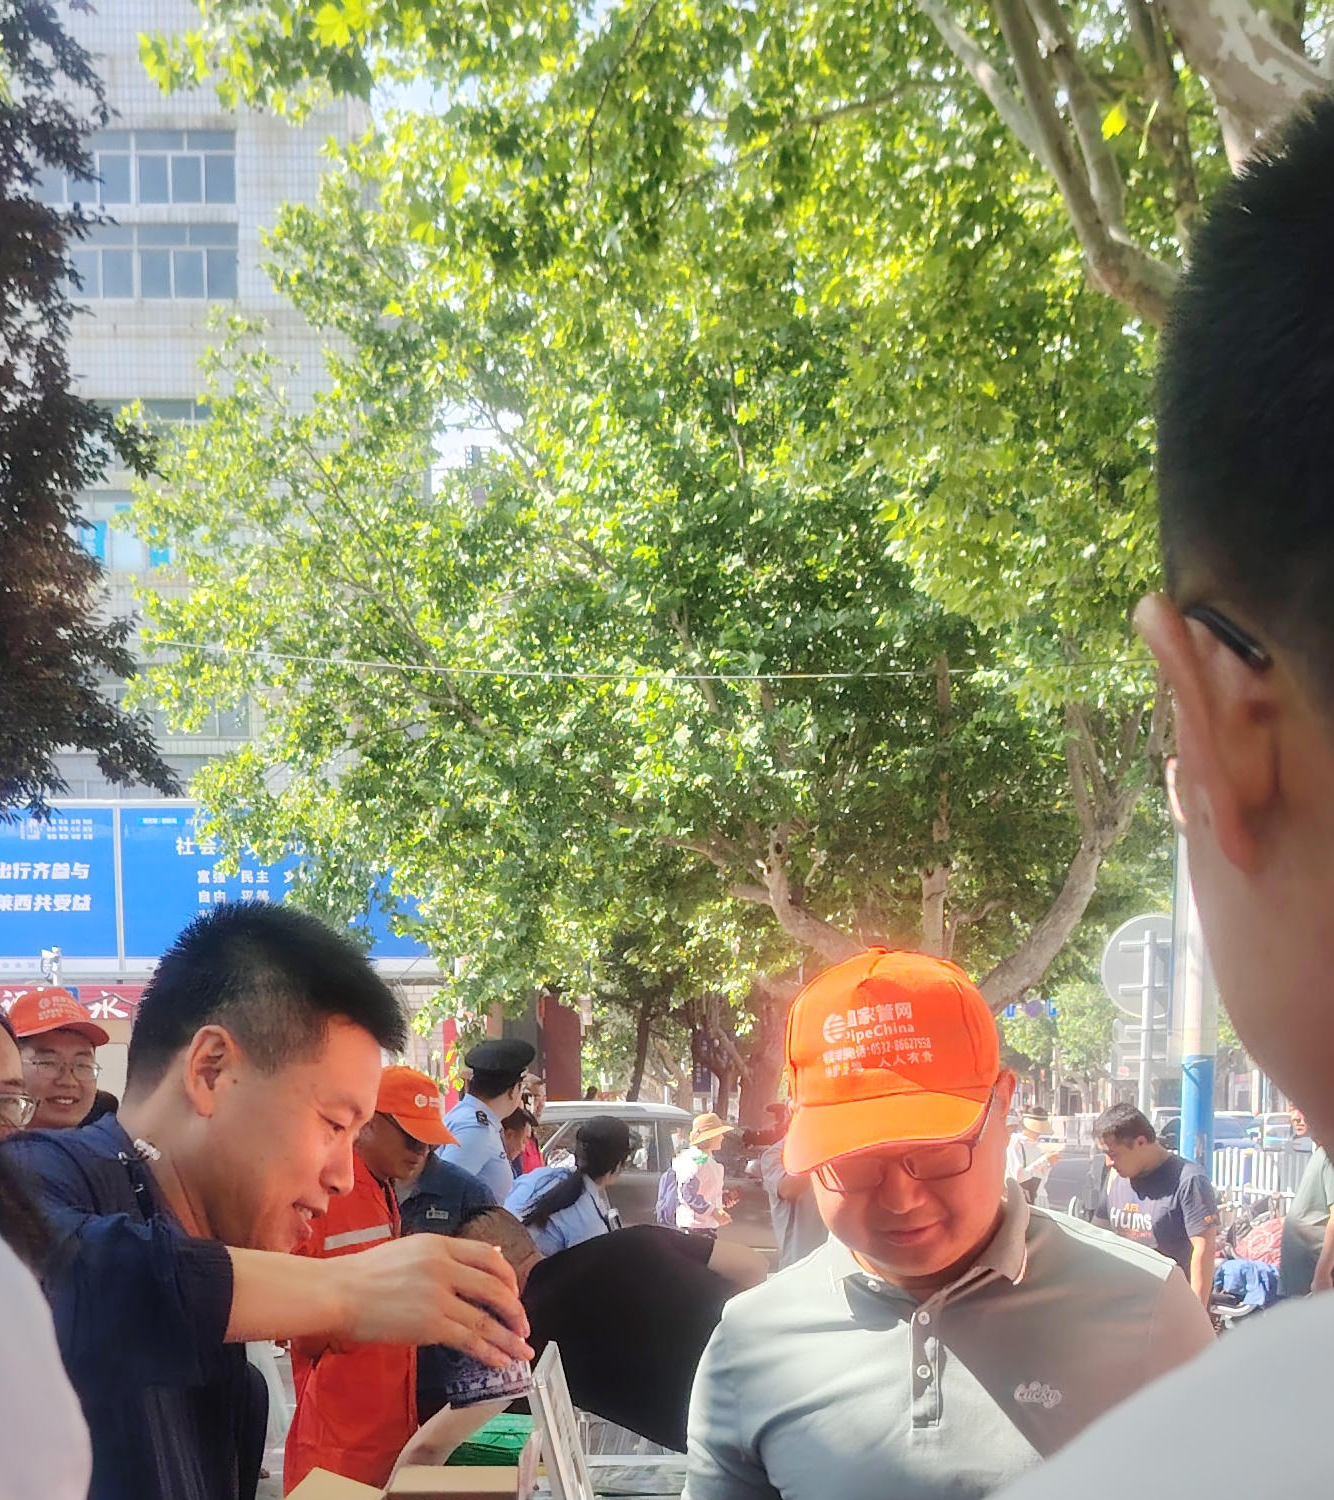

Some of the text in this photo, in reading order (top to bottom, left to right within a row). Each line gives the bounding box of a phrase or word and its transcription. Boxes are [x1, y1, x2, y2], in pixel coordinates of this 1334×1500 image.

[197, 869, 227, 884] 富强
[241, 869, 269, 884] 民主
[198, 889, 226, 904] 自由
